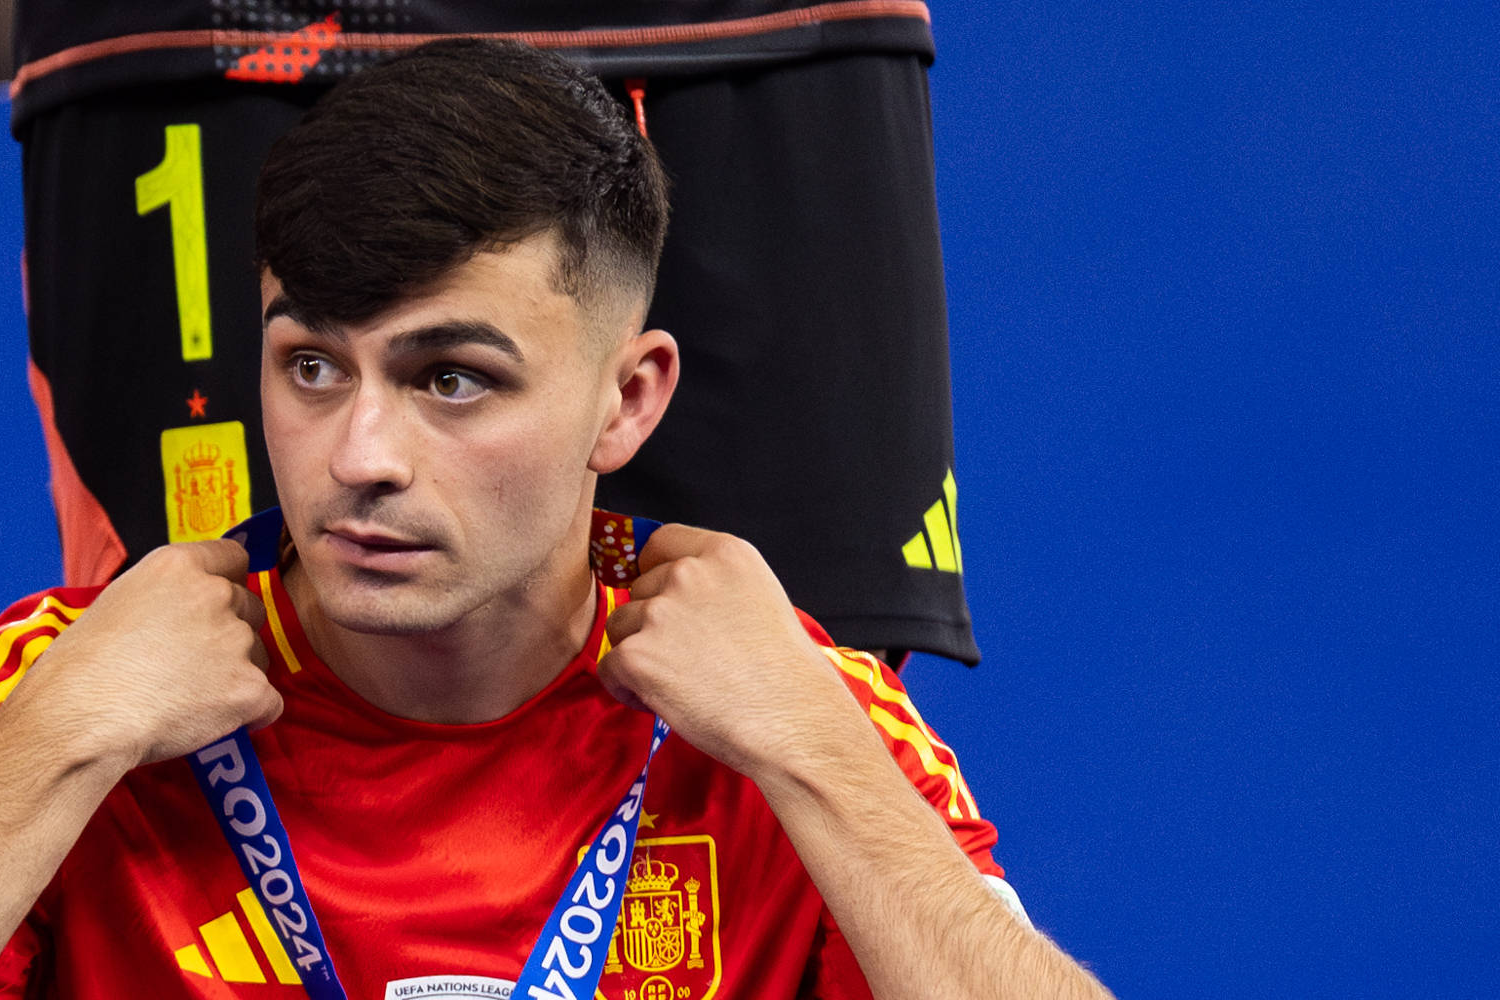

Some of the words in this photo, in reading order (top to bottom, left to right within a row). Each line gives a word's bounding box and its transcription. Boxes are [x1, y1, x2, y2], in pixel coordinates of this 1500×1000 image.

[134, 123, 213, 363] 1
[394, 985, 424, 997] UEFA
[426, 982, 478, 993] NATIONS
[481, 983, 513, 998] LEAG
